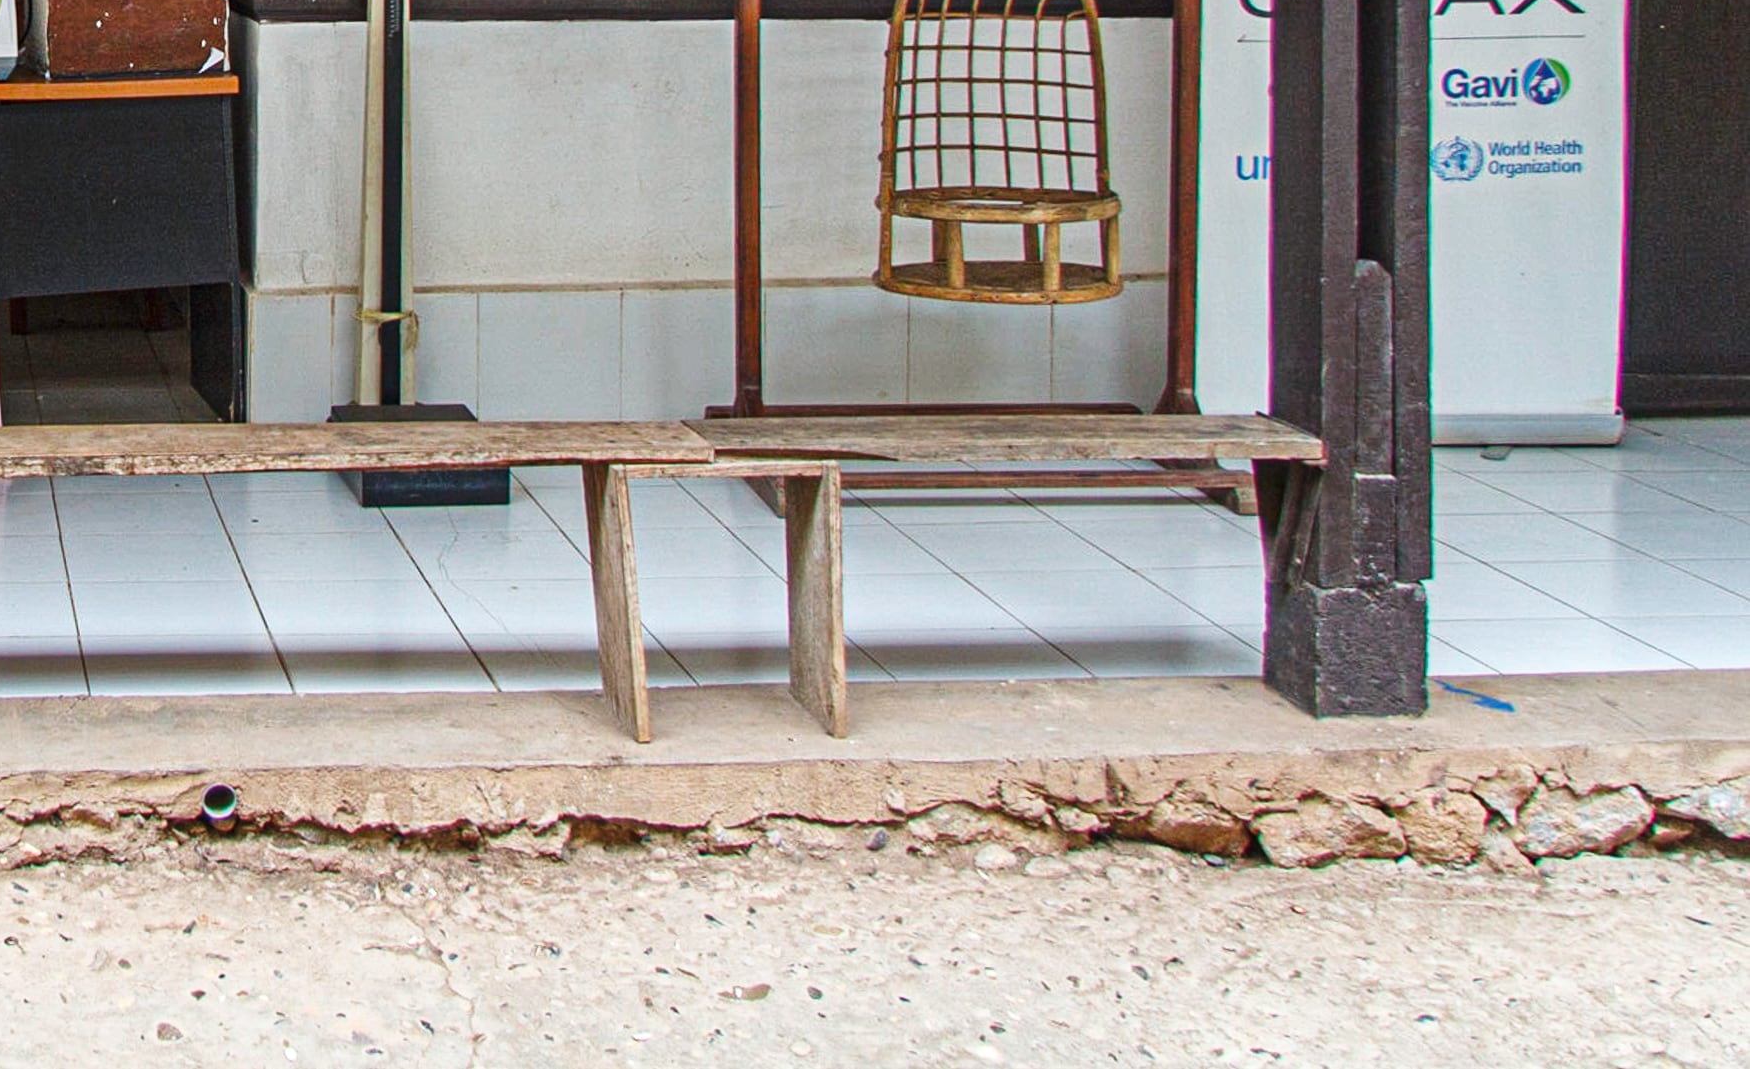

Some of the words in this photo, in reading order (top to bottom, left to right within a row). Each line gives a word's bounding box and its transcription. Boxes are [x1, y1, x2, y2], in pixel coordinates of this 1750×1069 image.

[1441, 67, 1519, 99] Gavi
[1488, 139, 1531, 156] World
[1533, 138, 1583, 155] Health
[1488, 157, 1583, 177] Organization
